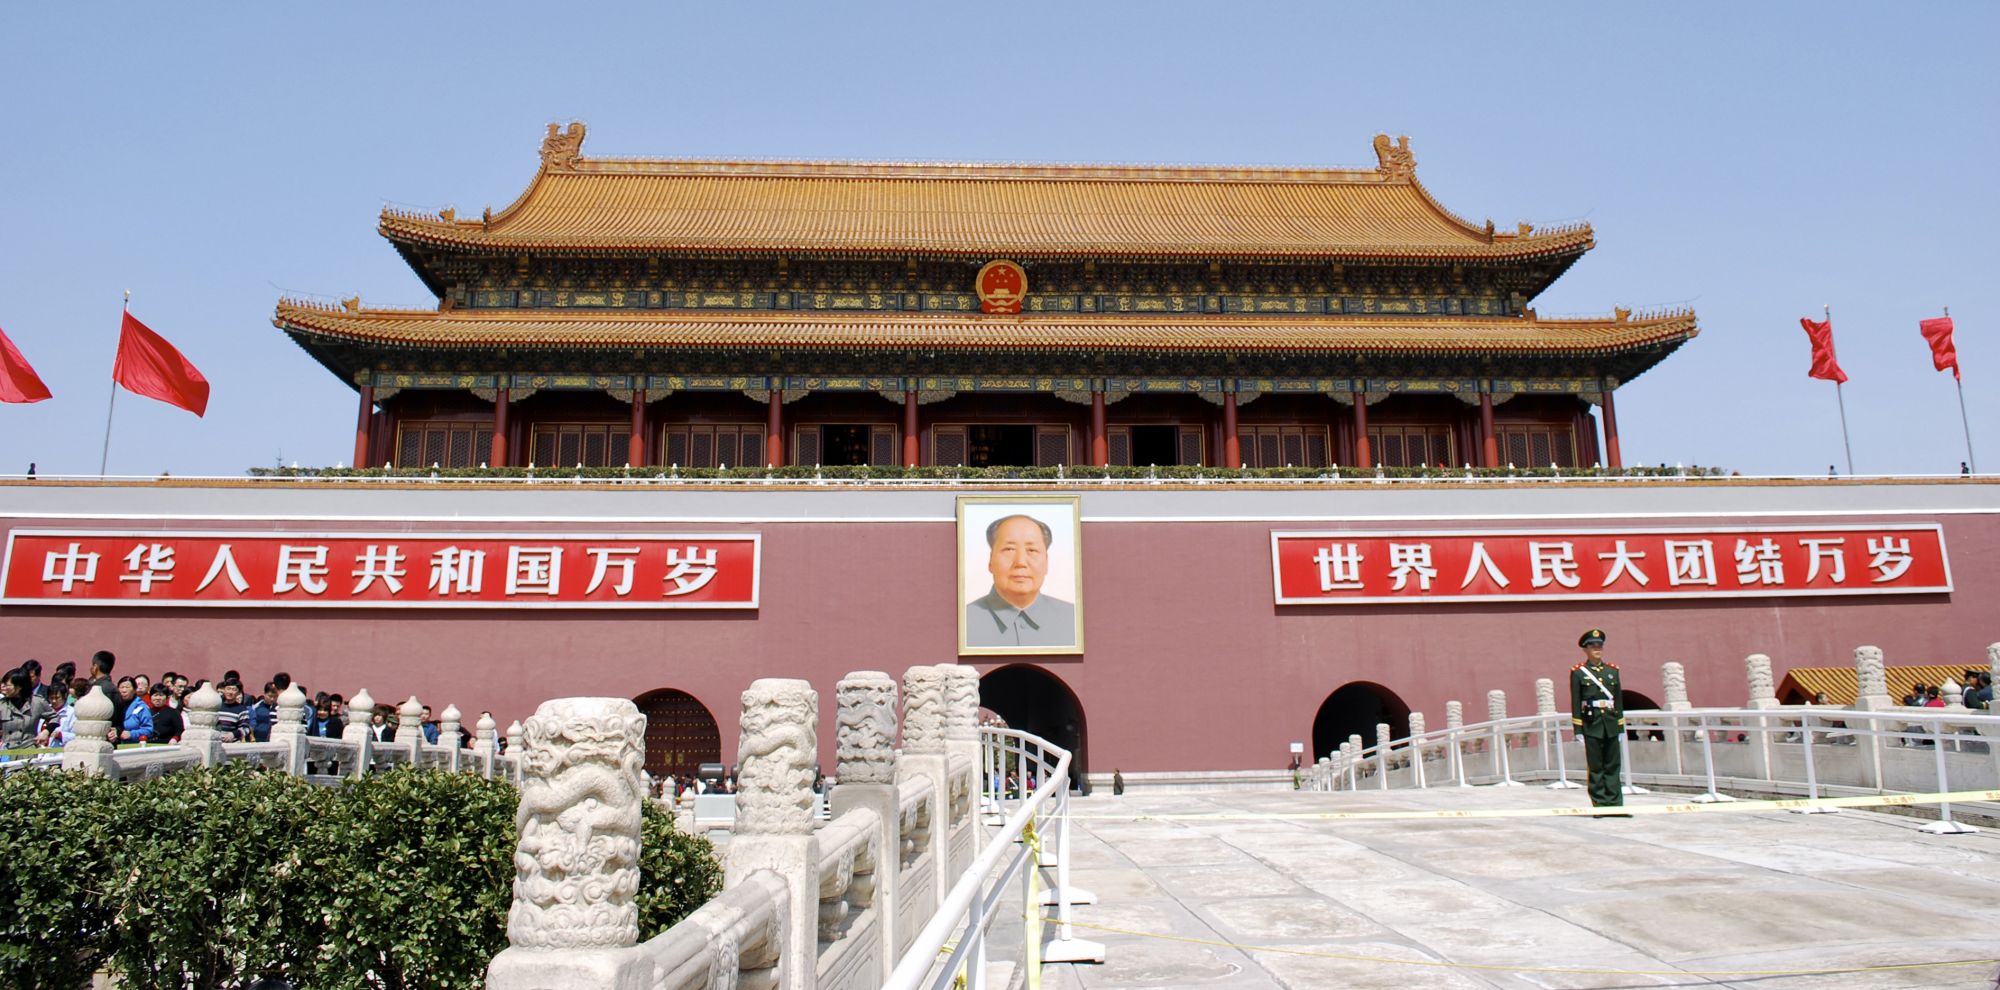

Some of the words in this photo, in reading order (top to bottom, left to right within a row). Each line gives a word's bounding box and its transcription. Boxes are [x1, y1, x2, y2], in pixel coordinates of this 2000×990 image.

[42, 543, 719, 596] 中华人民共和国万岁
[1313, 537, 1914, 591] 世界人民大团结万岁
